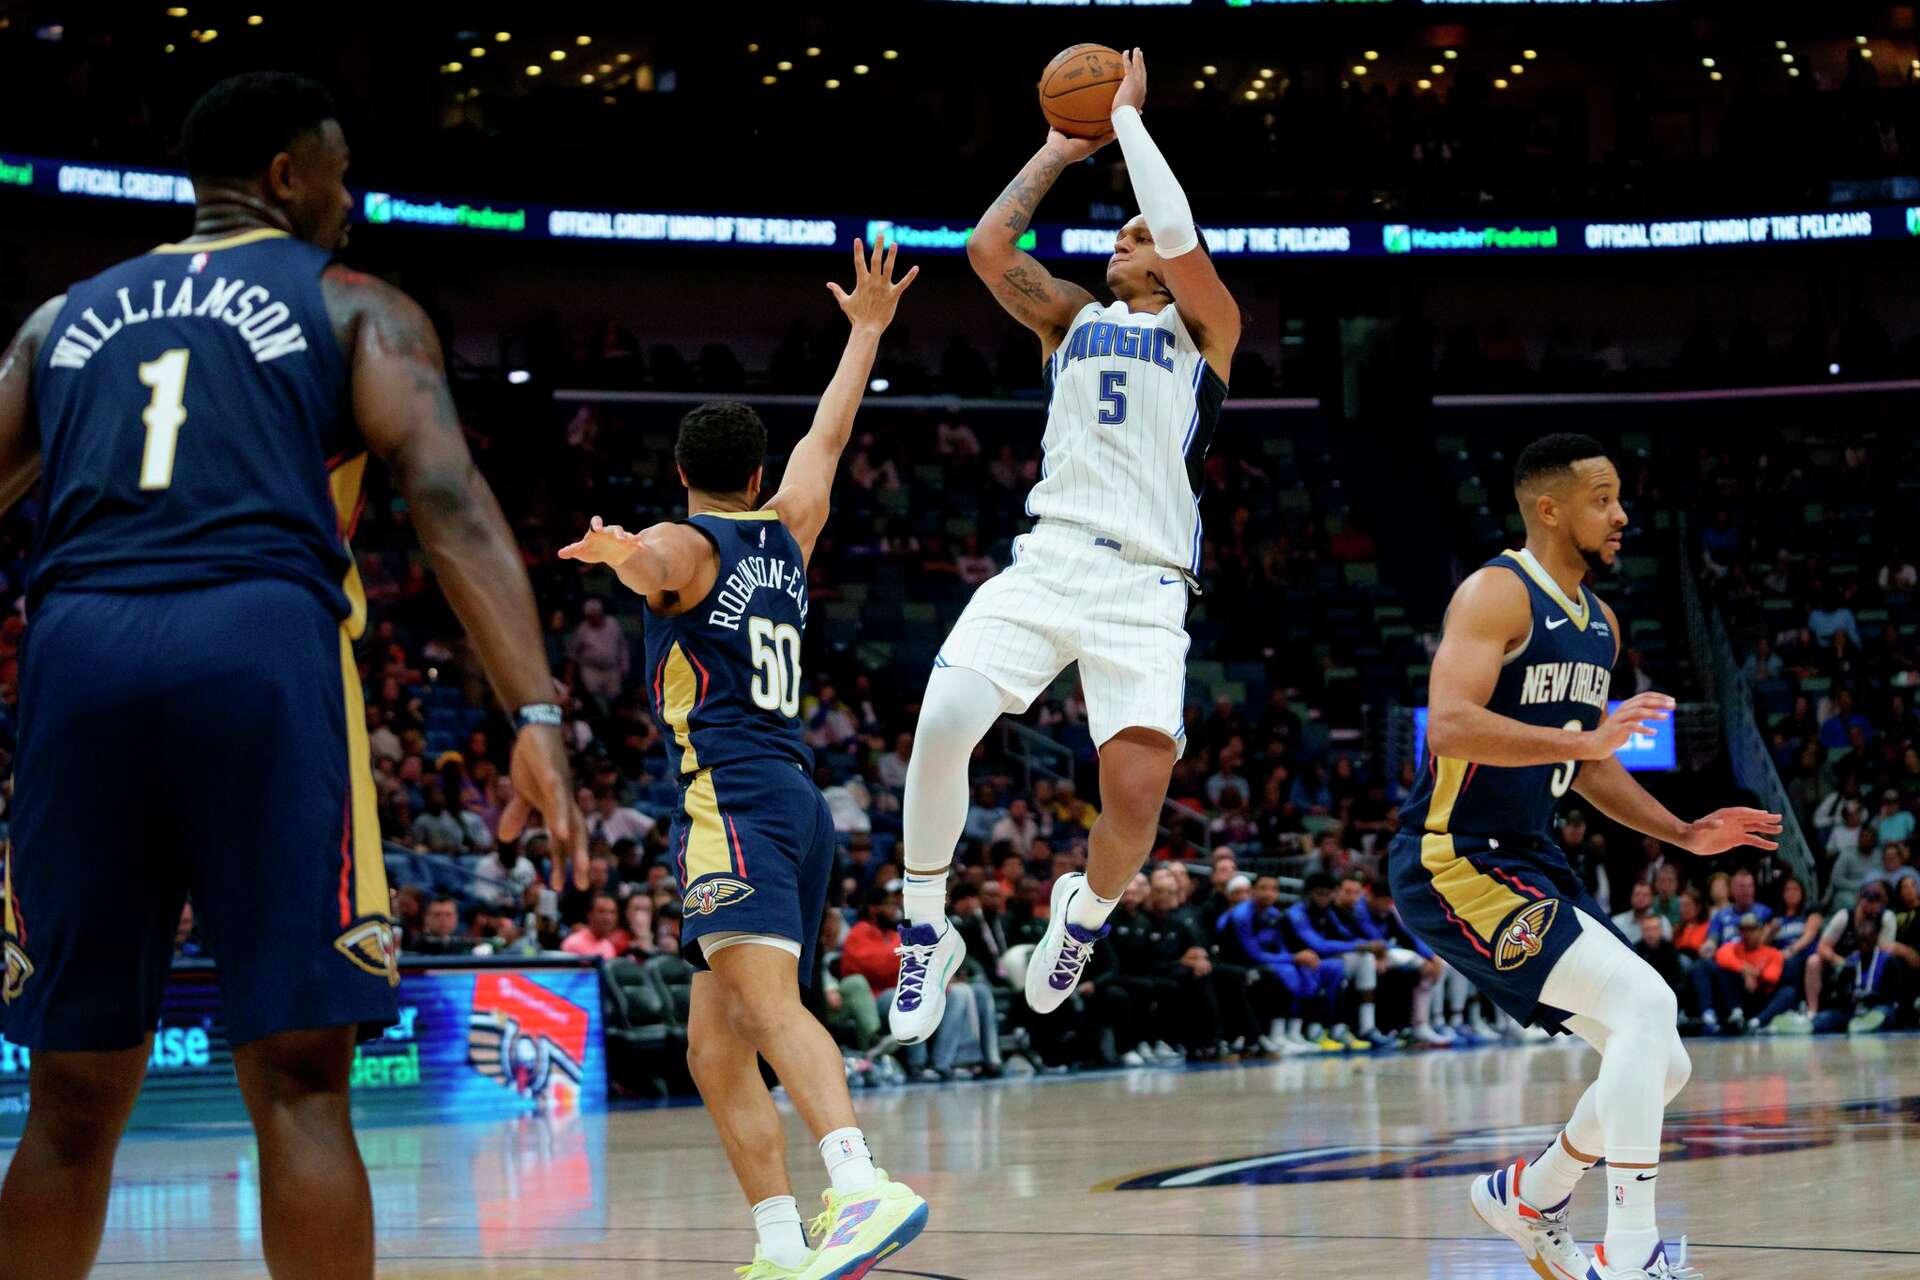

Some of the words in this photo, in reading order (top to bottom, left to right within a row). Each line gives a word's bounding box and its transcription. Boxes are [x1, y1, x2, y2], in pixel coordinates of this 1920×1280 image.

[59, 166, 122, 197] OFFICIAL
[123, 171, 174, 201] CREDIT
[549, 210, 613, 238] OFFICIAL
[614, 213, 666, 239] CREDIT
[667, 215, 715, 241] UNION
[716, 217, 735, 242] OF
[736, 218, 764, 243] THE
[765, 219, 836, 246] PELICANS
[1227, 228, 1248, 253] OF
[1249, 228, 1277, 252] THE
[1278, 227, 1350, 252] PELICANS
[1585, 223, 1649, 248] OFFICIAL
[1650, 221, 1701, 247] CREDIT
[1702, 219, 1749, 244] UNION
[1750, 217, 1768, 242] OF
[1770, 216, 1799, 240] THE
[1800, 212, 1871, 239] PELICANS
[50, 277, 308, 369] WILLIAMSON
[1061, 320, 1176, 373] MAGIC
[138, 348, 190, 491] 1
[1098, 370, 1127, 425] 5
[748, 615, 802, 719] 50
[1520, 662, 1573, 705] NEW
[1569, 661, 1611, 711] ORLEA
